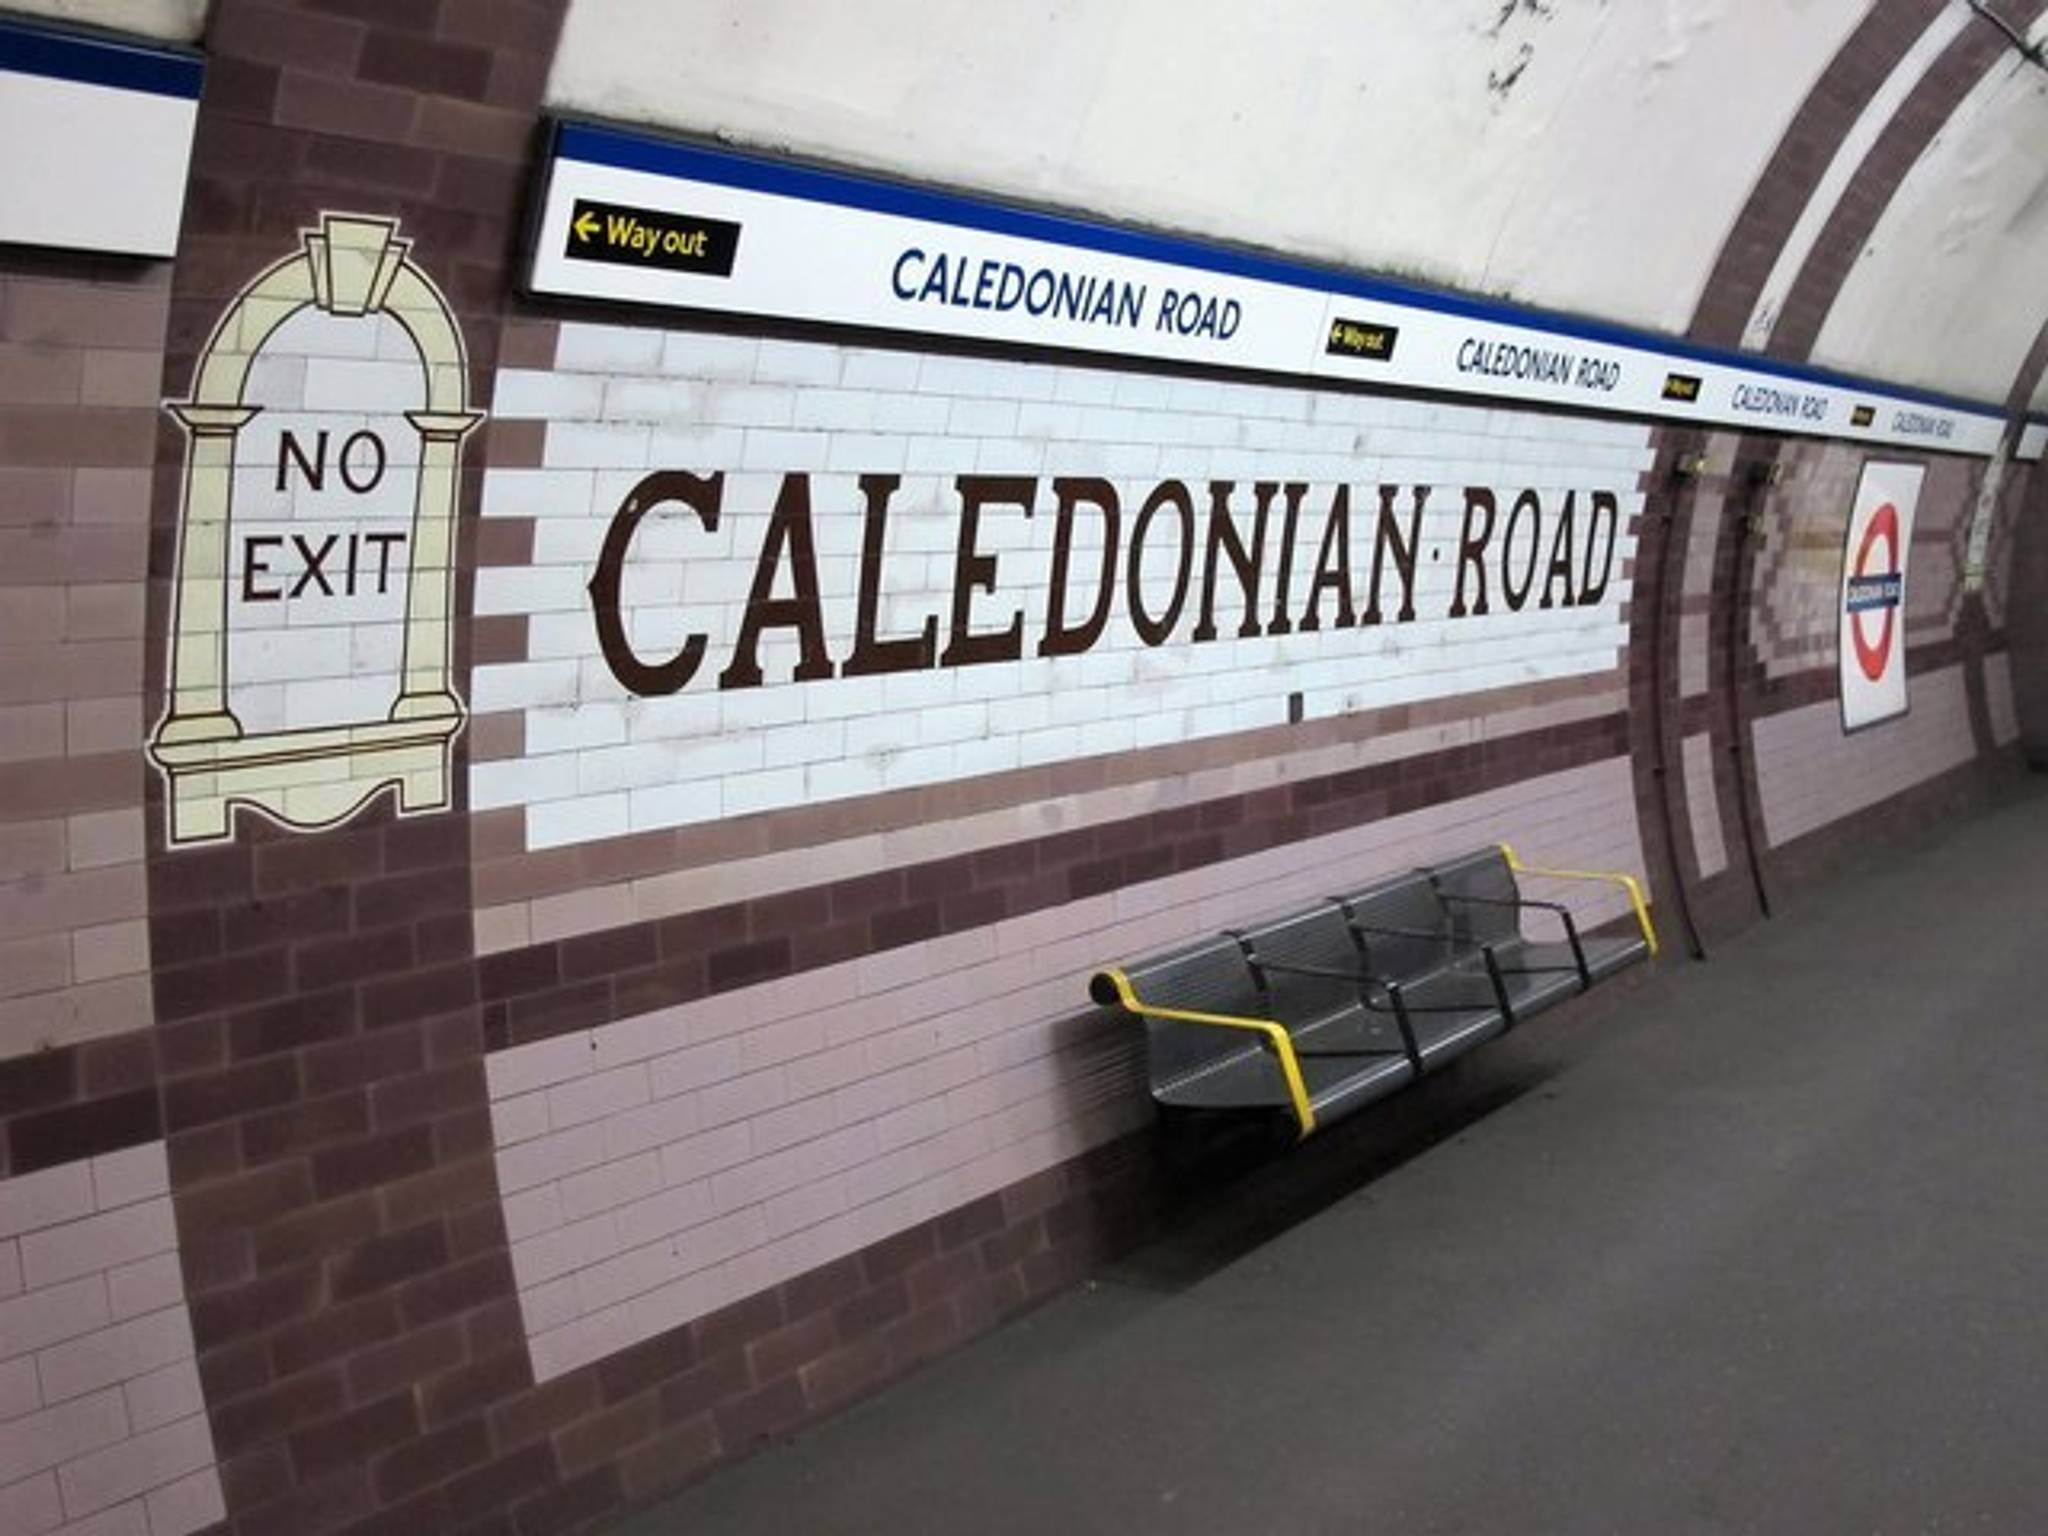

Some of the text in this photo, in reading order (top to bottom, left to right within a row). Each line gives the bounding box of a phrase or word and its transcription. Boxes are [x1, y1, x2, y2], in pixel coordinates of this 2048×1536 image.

[606, 214, 709, 258] Way out
[891, 248, 1241, 341] CALEDONIAN ROAD
[1456, 337, 1575, 386] CALEDONIAN
[1574, 357, 1621, 392] ROAD
[275, 429, 386, 494] NO
[242, 532, 407, 603] EXIT
[586, 469, 1618, 698] CALEDONIAN ROAD
